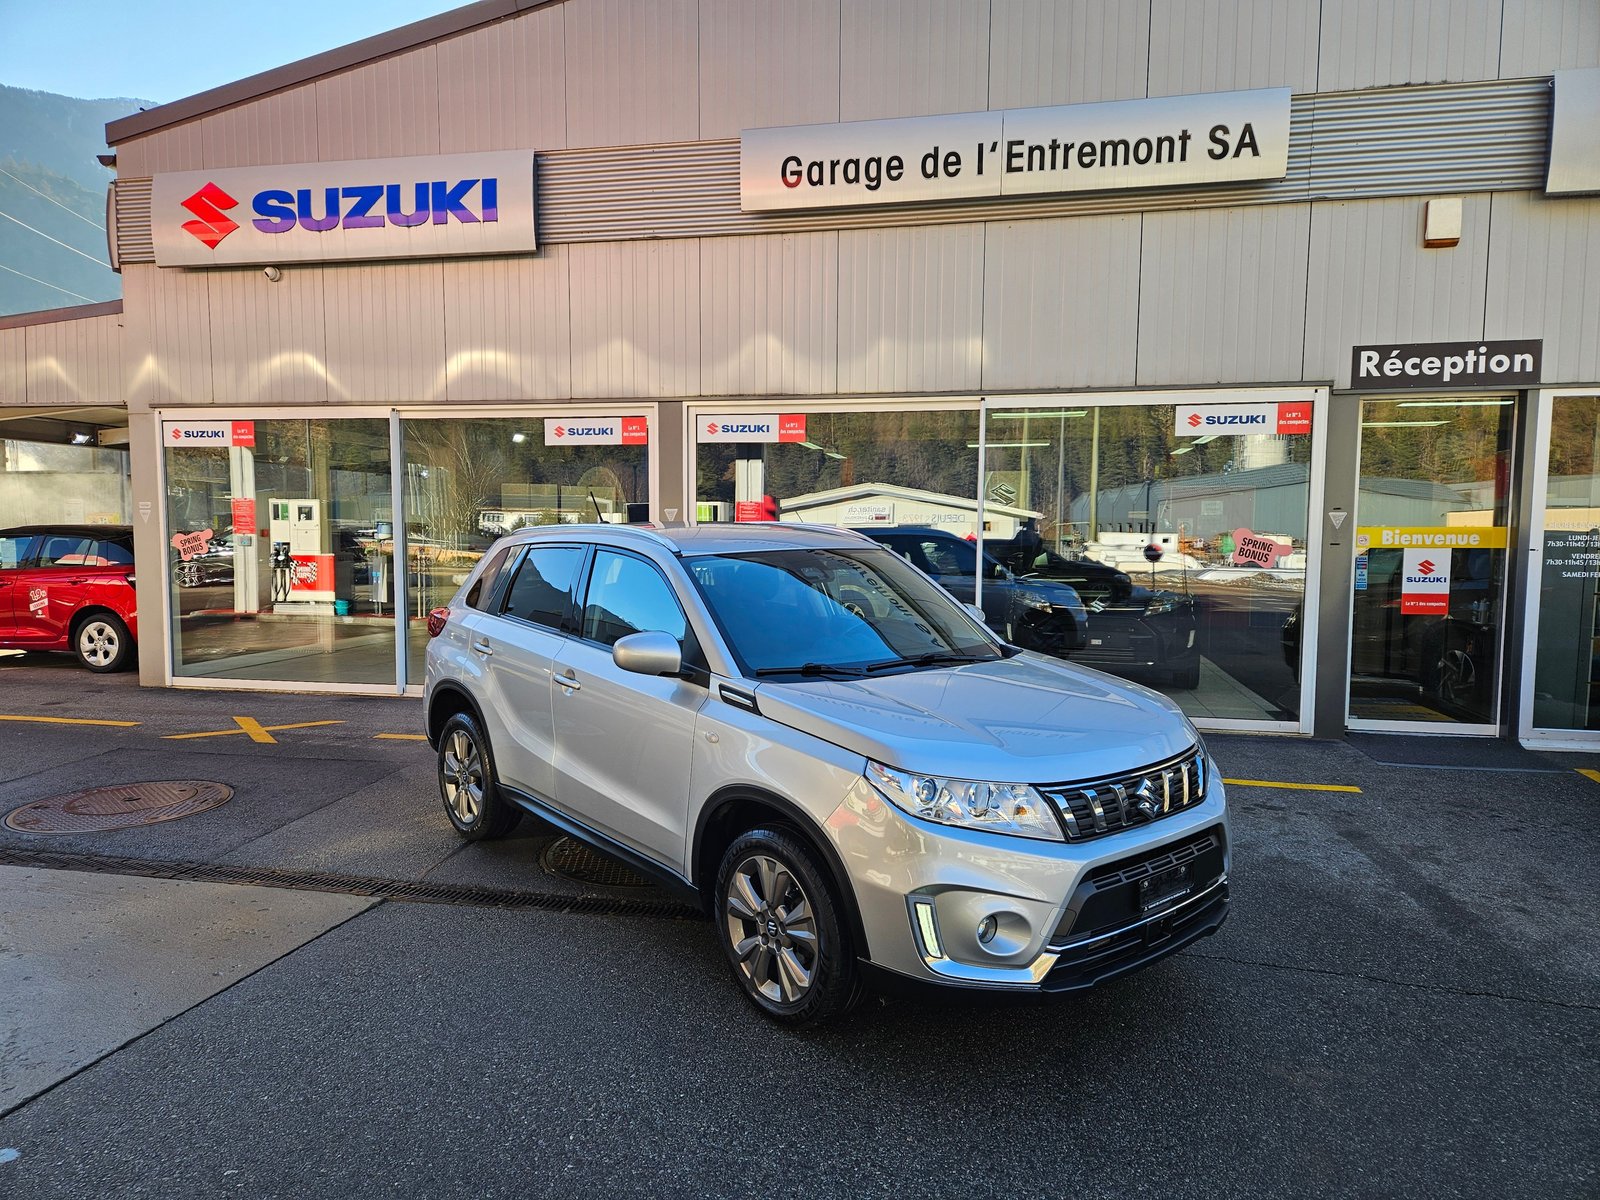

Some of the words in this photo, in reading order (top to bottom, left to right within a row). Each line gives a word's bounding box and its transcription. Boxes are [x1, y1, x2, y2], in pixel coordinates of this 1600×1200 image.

[780, 155, 904, 191] Garage
[921, 146, 962, 179] de
[1207, 123, 1261, 160] SA
[251, 177, 498, 234] SUZUKI
[1359, 345, 1534, 382] Réception
[1205, 415, 1266, 425] SUZUKI
[184, 430, 225, 438] SUZUKI
[567, 427, 614, 436] SUZUKI
[721, 424, 770, 433] SUZUKI
[180, 535, 202, 548] SPRING
[1382, 529, 1481, 545] Bienvenue
[182, 542, 204, 556] BONUS
[1241, 537, 1273, 553] SPRING
[1238, 546, 1270, 563] BONUS
